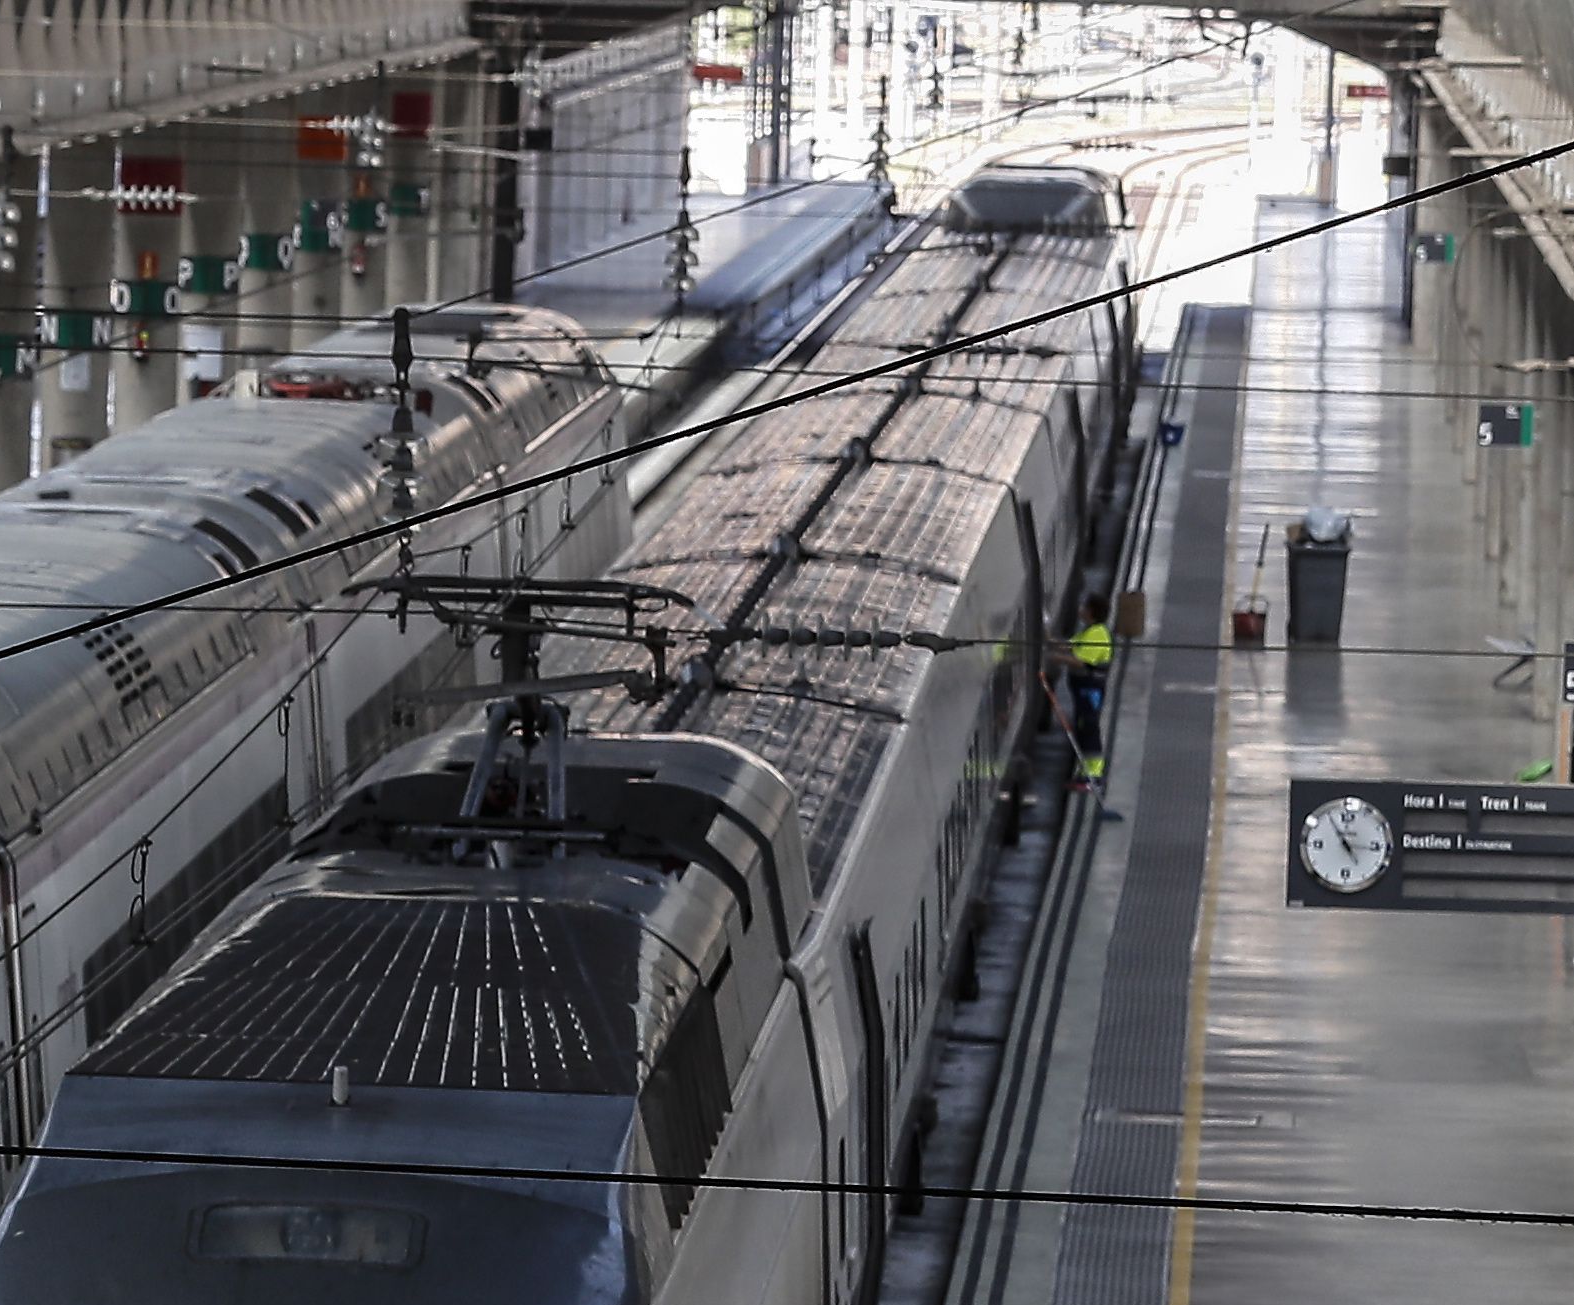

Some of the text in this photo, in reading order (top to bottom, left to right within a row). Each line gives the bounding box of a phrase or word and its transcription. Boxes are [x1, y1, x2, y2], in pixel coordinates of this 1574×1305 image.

[1404, 794, 1435, 808] Hora
[1481, 795, 1510, 810] Tren
[1403, 834, 1451, 849] Destino
